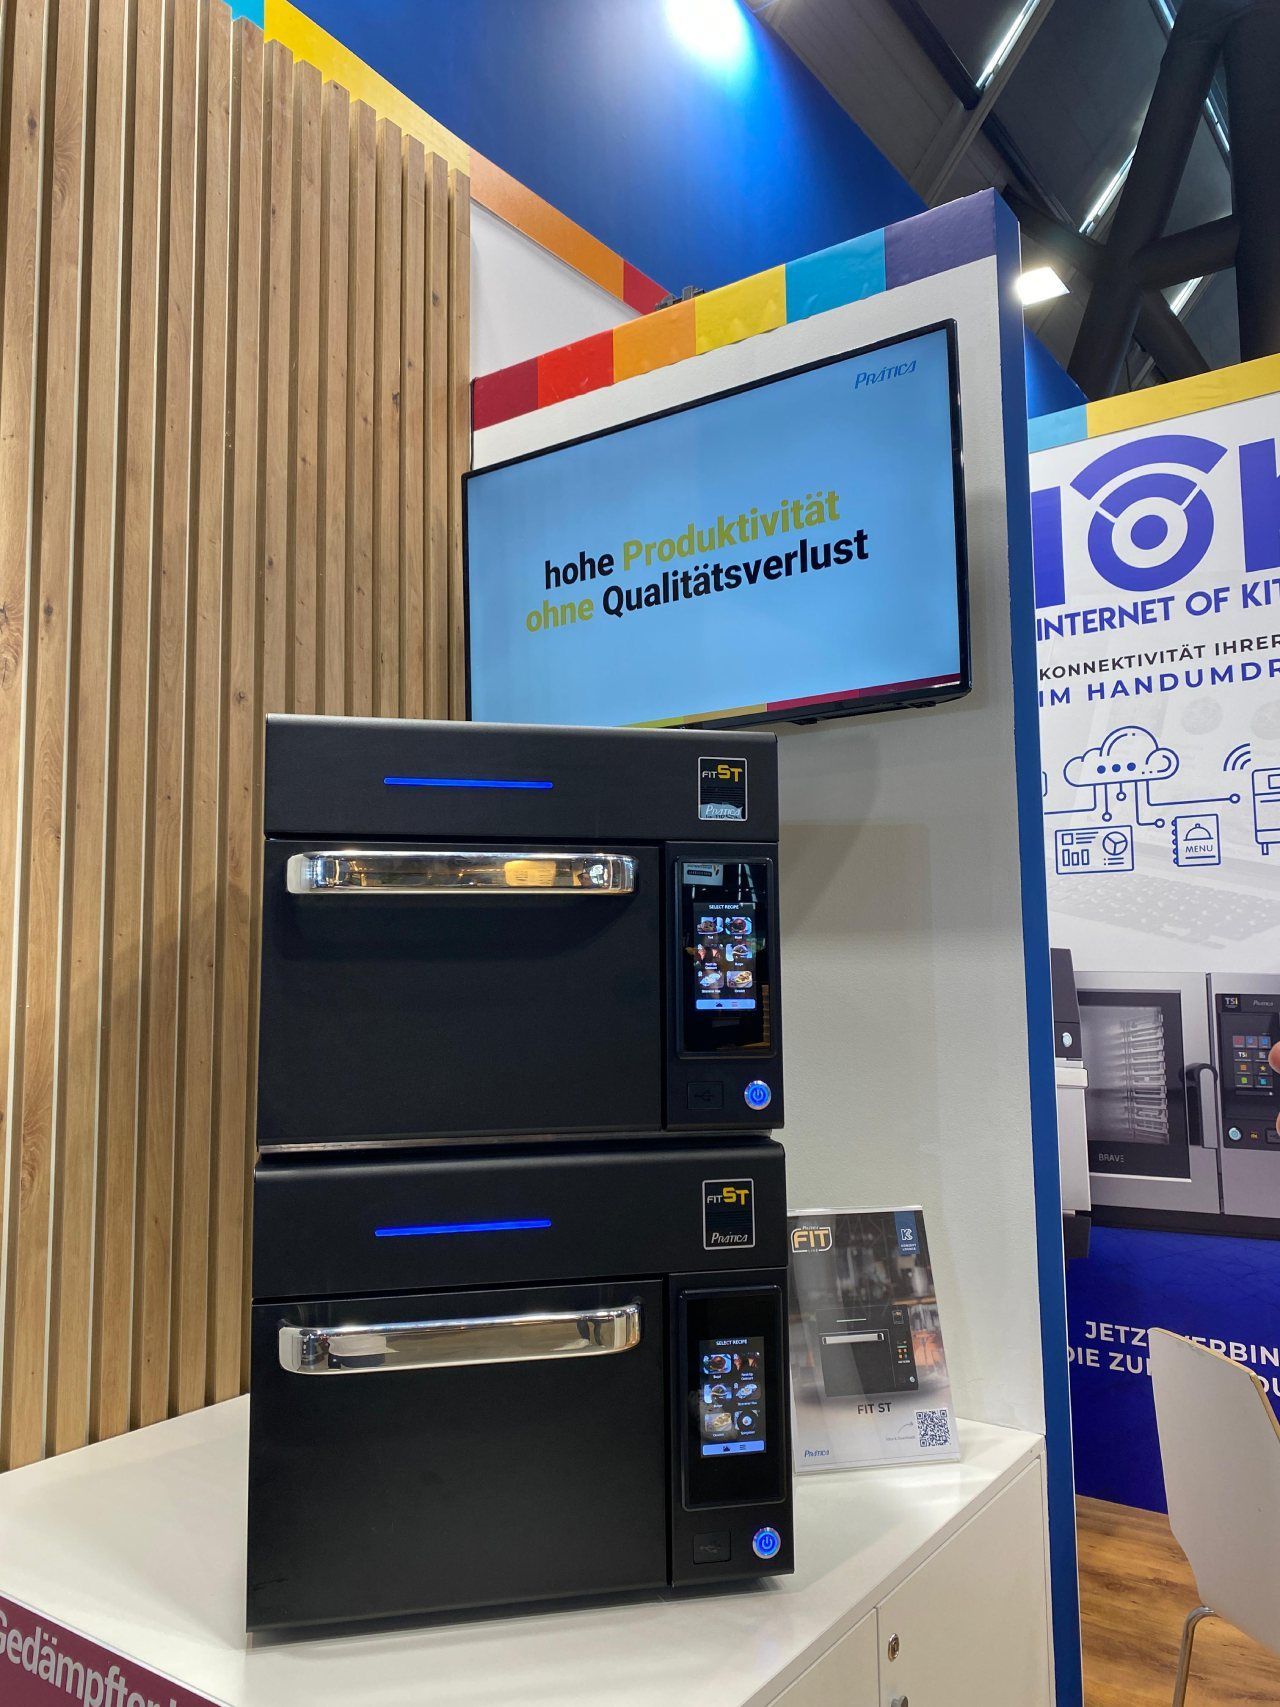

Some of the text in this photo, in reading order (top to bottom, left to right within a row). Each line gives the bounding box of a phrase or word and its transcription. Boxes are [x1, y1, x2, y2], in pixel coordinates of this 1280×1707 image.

[544, 490, 840, 590] hohe Produktivität
[525, 528, 869, 633] ohne Qualitätsverlust
[1036, 595, 1175, 641] INTERNET
[1185, 586, 1230, 616] OF
[1039, 633, 1280, 681] KONNEKTIVITÄT IHRER
[1039, 686, 1071, 708] IM
[1185, 844, 1213, 854] MENU
[1098, 1153, 1125, 1163] BRAVE
[793, 1230, 829, 1249] FIT
[1085, 1320, 1280, 1367] JETZ RBIN
[1108, 1351, 1153, 1376] ZU
[857, 1402, 892, 1414] FIT ST
[0, 1610, 161, 1707] edämpft
